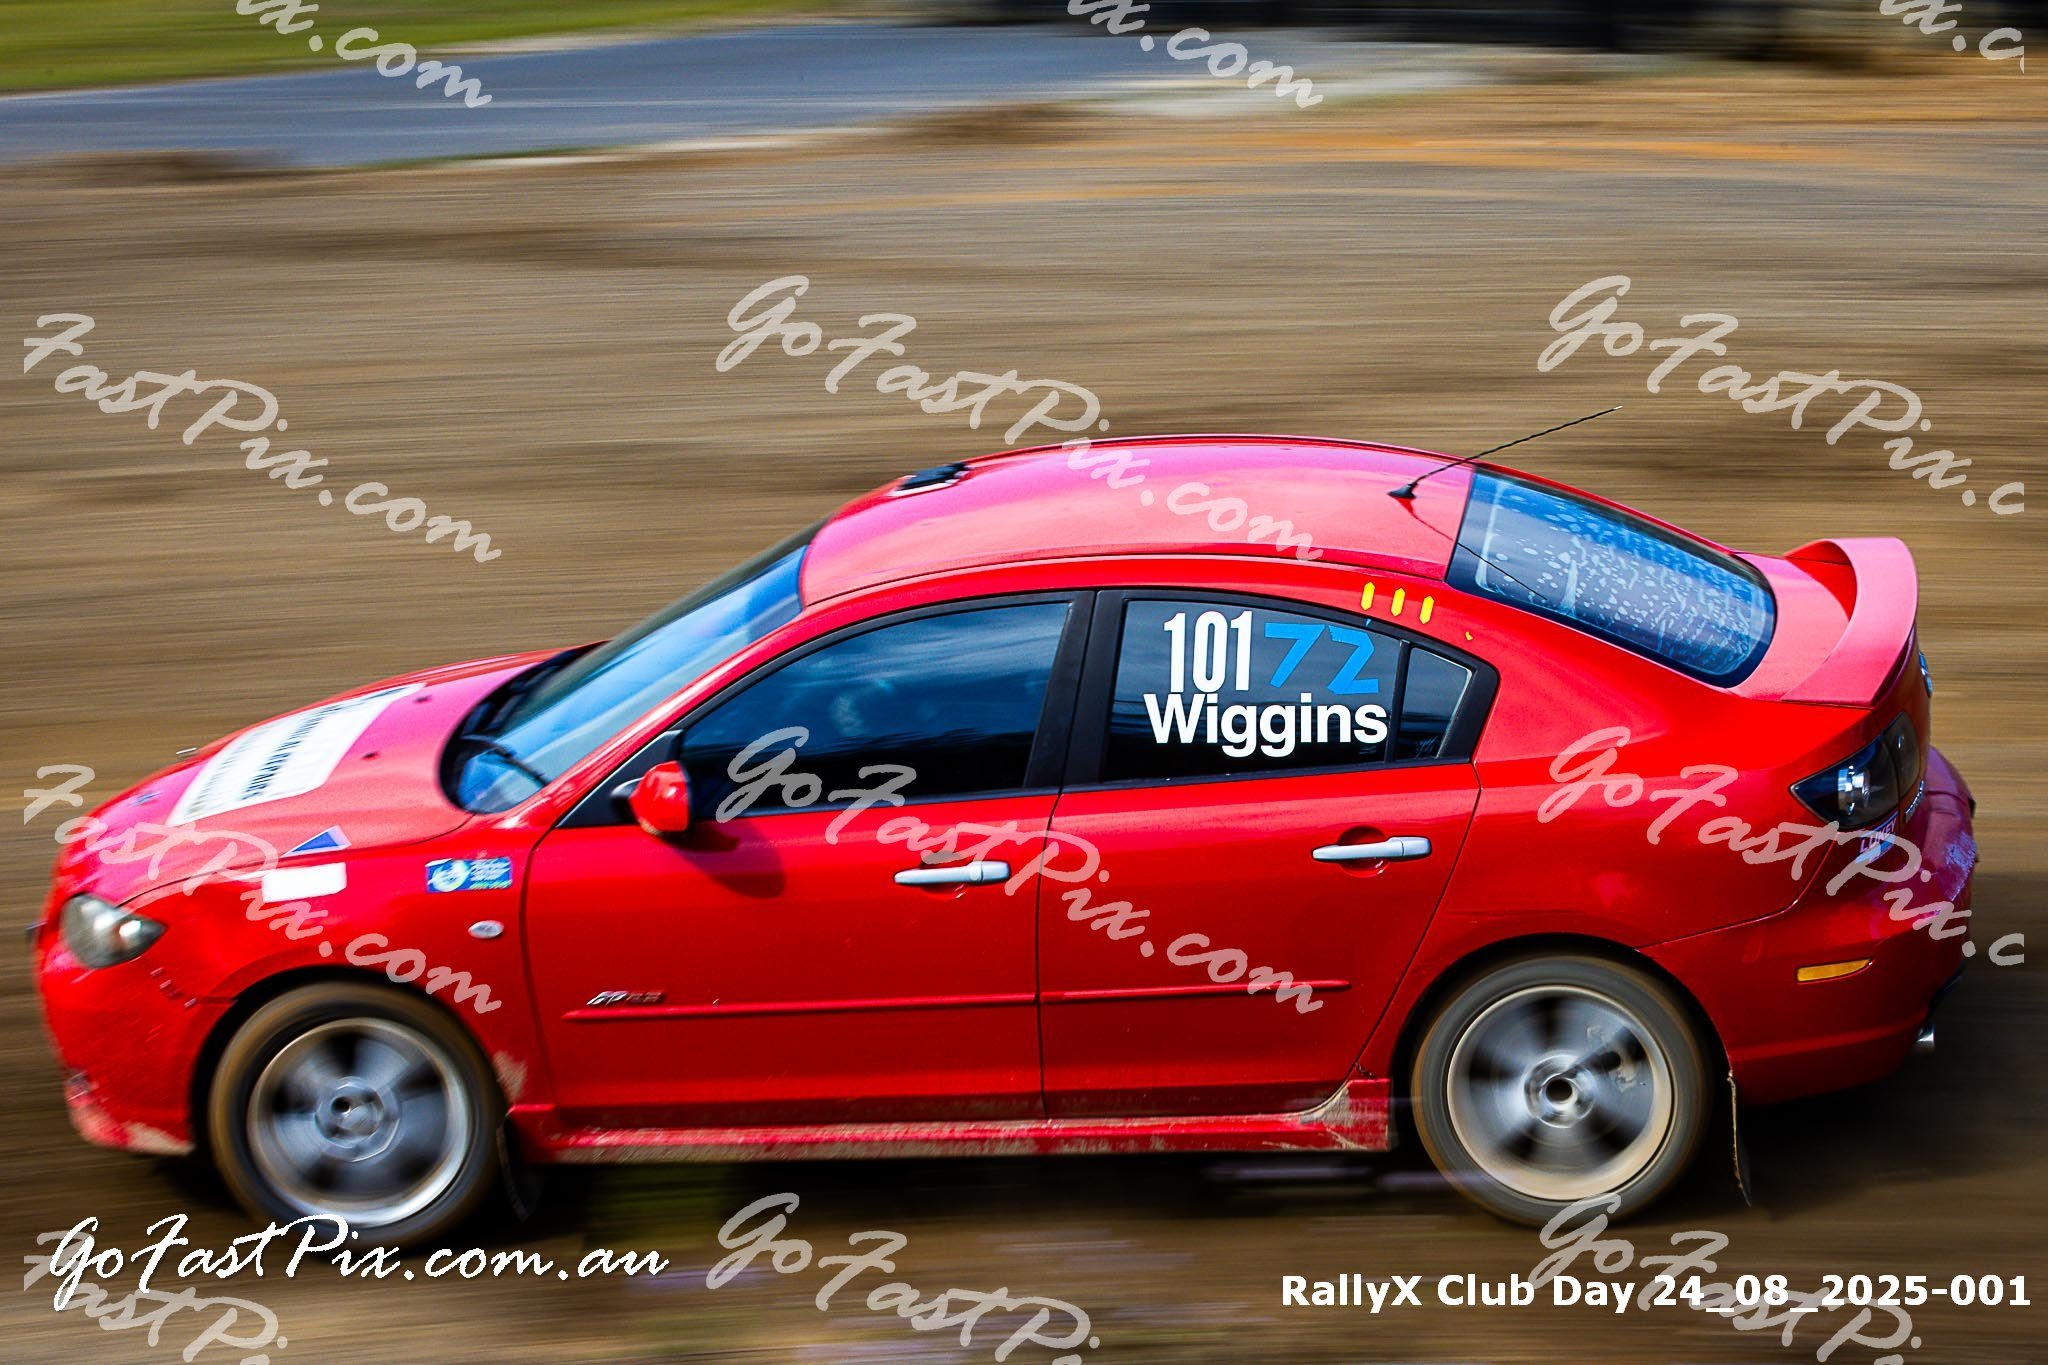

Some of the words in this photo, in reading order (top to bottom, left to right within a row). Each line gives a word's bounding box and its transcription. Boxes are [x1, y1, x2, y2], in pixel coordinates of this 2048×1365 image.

[1163, 611, 1253, 693] 101
[1264, 622, 1379, 695] 72
[1143, 692, 1388, 758] Wiggins
